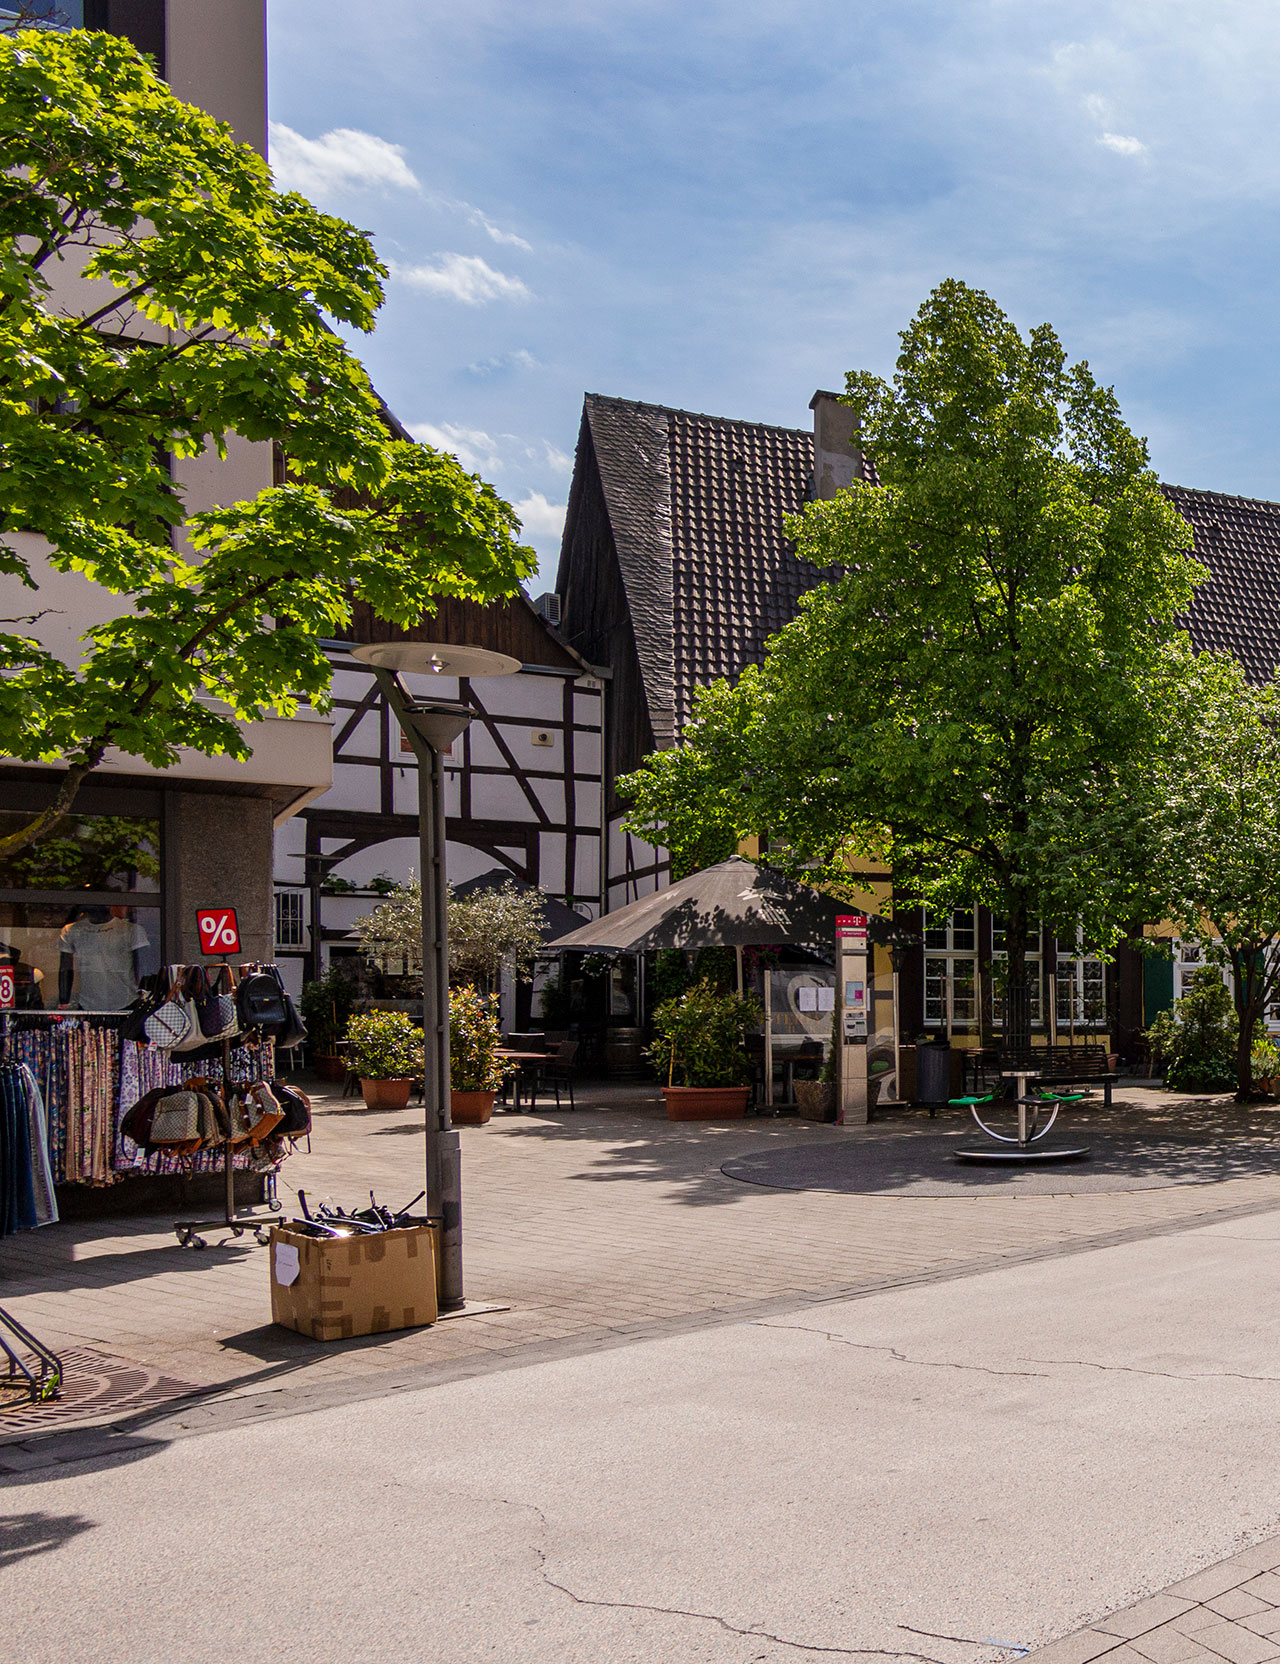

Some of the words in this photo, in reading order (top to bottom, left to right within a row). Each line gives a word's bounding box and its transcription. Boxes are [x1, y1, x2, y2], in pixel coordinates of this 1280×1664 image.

[201, 915, 236, 947] %
[853, 916, 861, 926] T
[1, 979, 10, 999] 8
